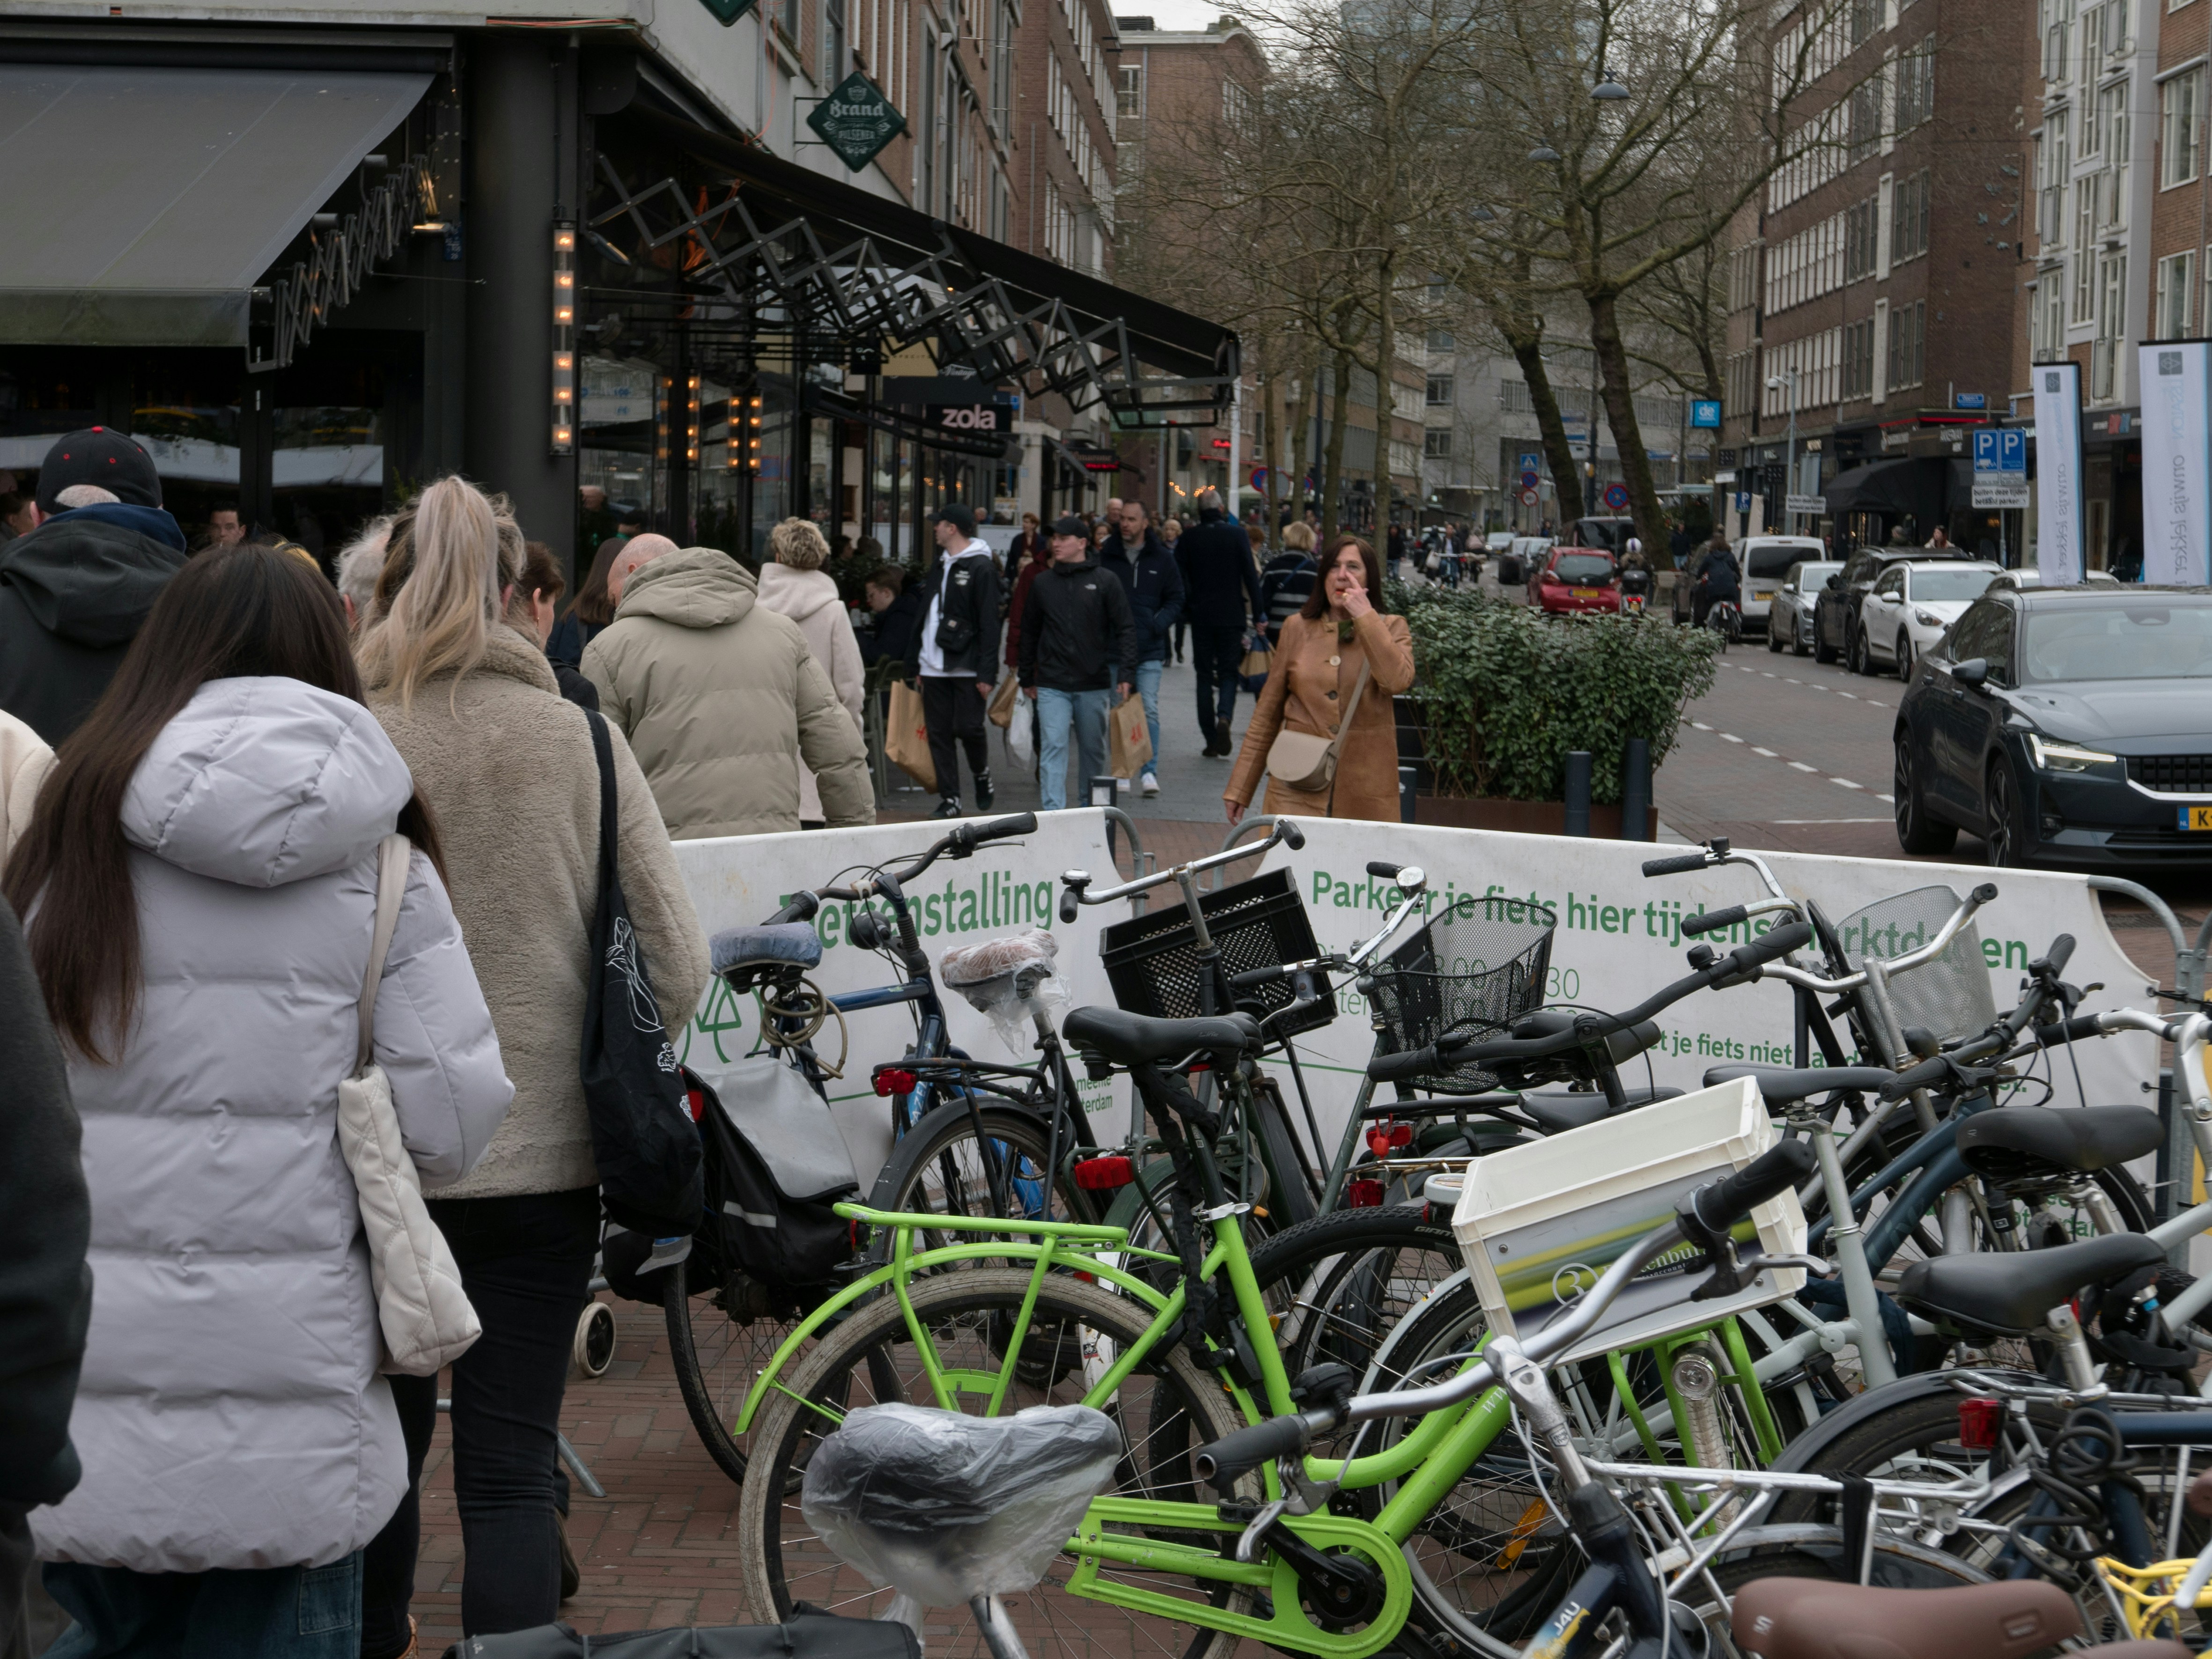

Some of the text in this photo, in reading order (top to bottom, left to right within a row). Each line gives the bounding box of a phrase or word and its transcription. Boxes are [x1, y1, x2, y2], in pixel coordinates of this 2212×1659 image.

[829, 99, 885, 118] Brand
[941, 404, 996, 430] zola
[1979, 434, 1993, 456] P
[2005, 433, 2019, 455] P
[779, 870, 1053, 949] etenstalling
[1445, 882, 1475, 926] je
[1483, 885, 1558, 928] fiets
[1567, 892, 1637, 934] hier
[1648, 1029, 1668, 1052] et
[1672, 1030, 1692, 1057] je
[1697, 1033, 1745, 1060] fiets
[1750, 1040, 1792, 1066] niet
[1076, 1076, 1112, 1092] meente
[1082, 1094, 1113, 1113] terdam
[1554, 1600, 1580, 1637] J4U
